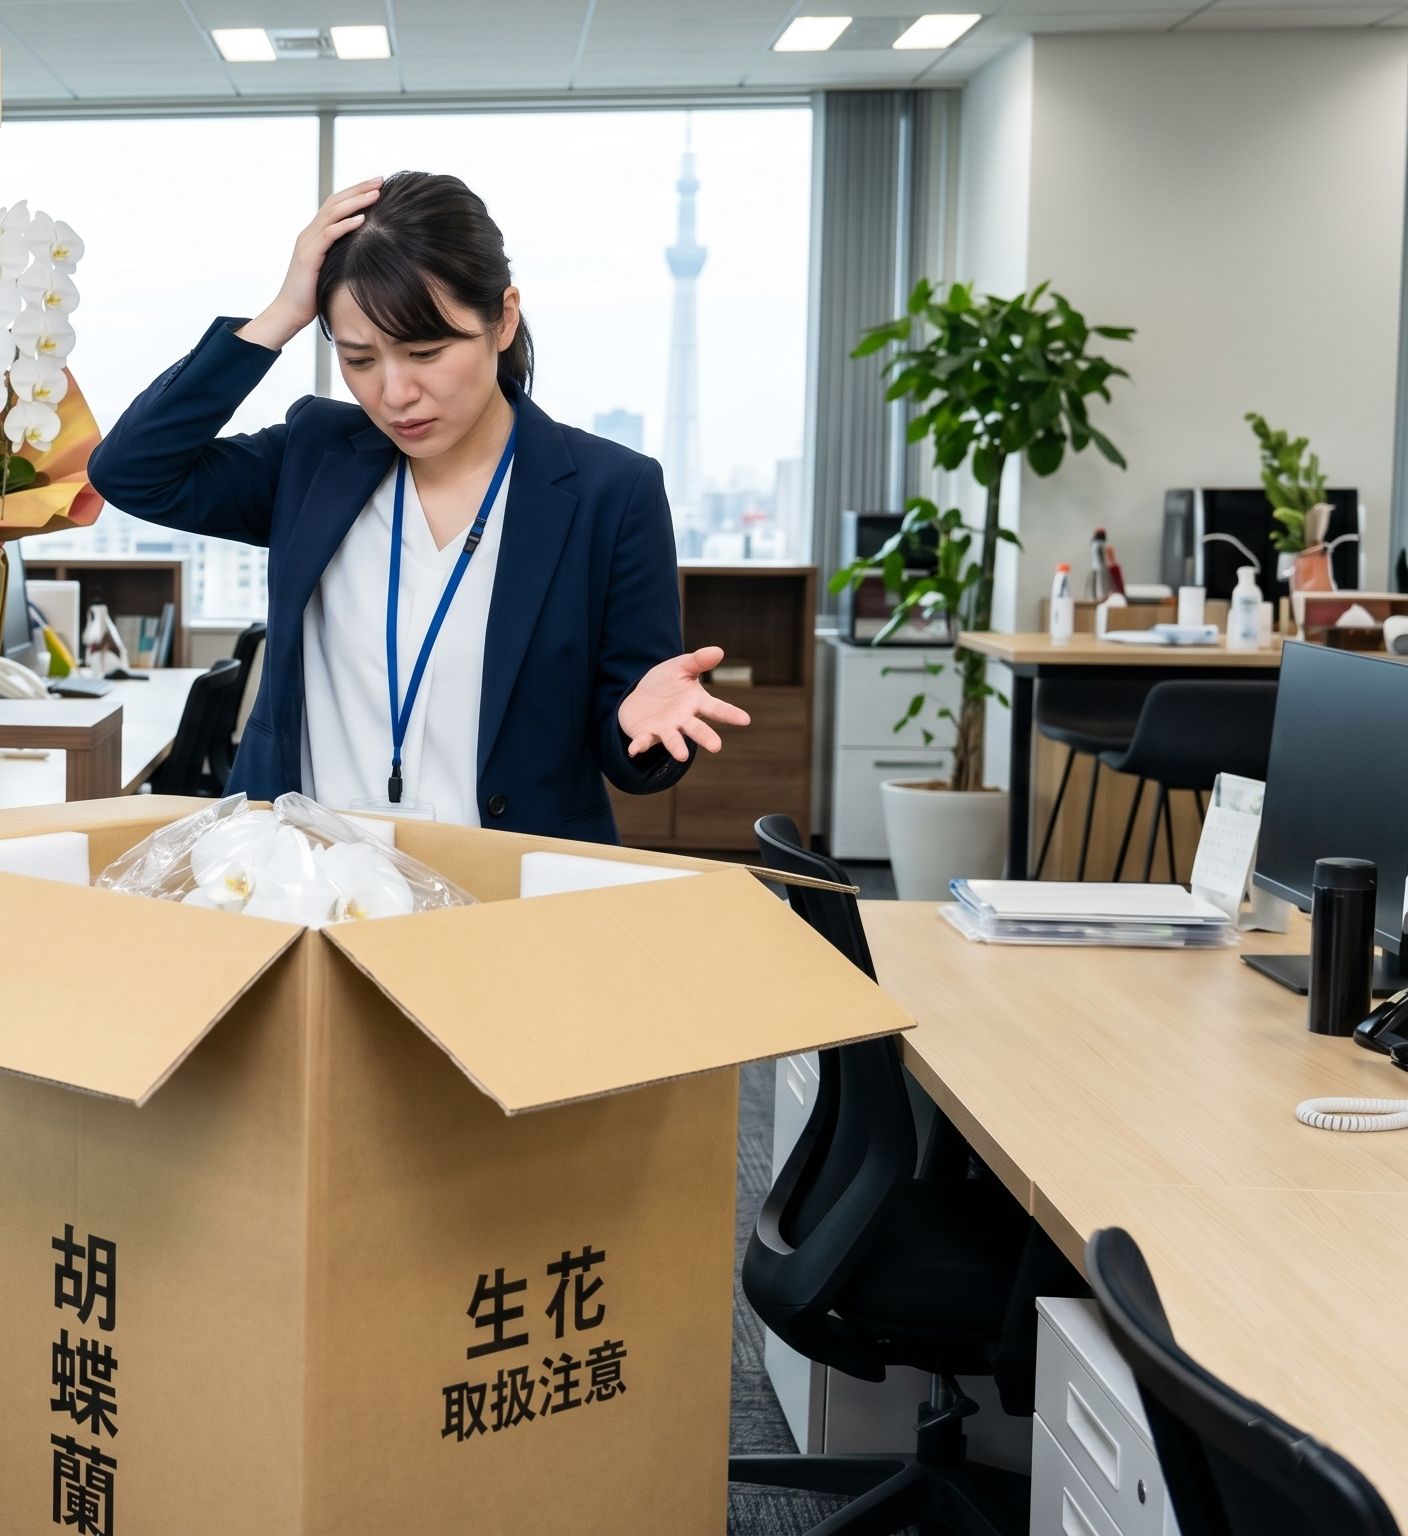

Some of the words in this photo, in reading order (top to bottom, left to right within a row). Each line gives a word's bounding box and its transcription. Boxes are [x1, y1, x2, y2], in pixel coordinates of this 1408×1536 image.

[466, 1245, 606, 1360] 生花
[50, 1223, 119, 1536] 胡蝶蘭
[441, 1339, 627, 1443] 取扱注意
